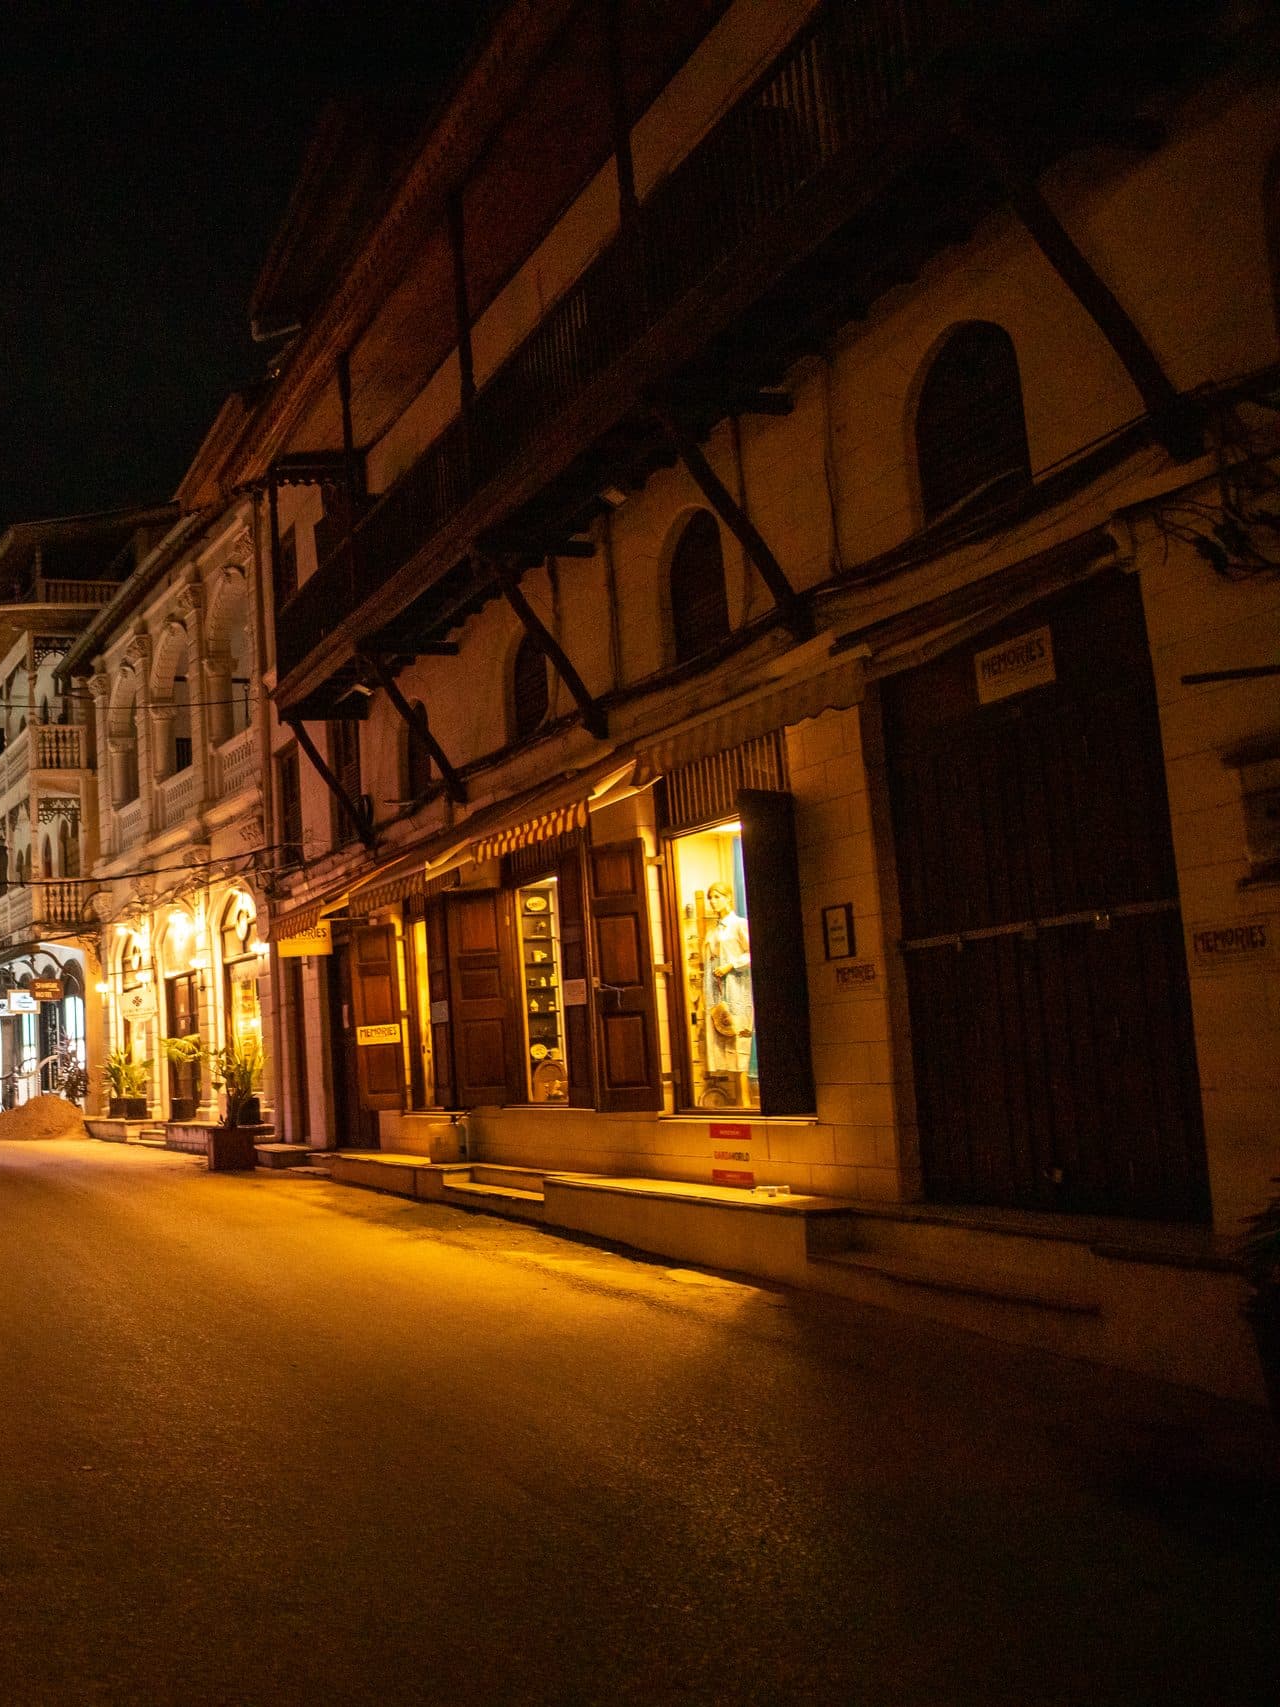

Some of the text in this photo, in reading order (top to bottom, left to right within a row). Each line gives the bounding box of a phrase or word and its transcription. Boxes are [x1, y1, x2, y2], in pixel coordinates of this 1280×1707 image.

[982, 639, 1045, 680] MEMORIES
[1193, 926, 1267, 953] MEMORIES
[835, 964, 876, 984] MEMORIES
[359, 1027, 397, 1040] MEMORIES
